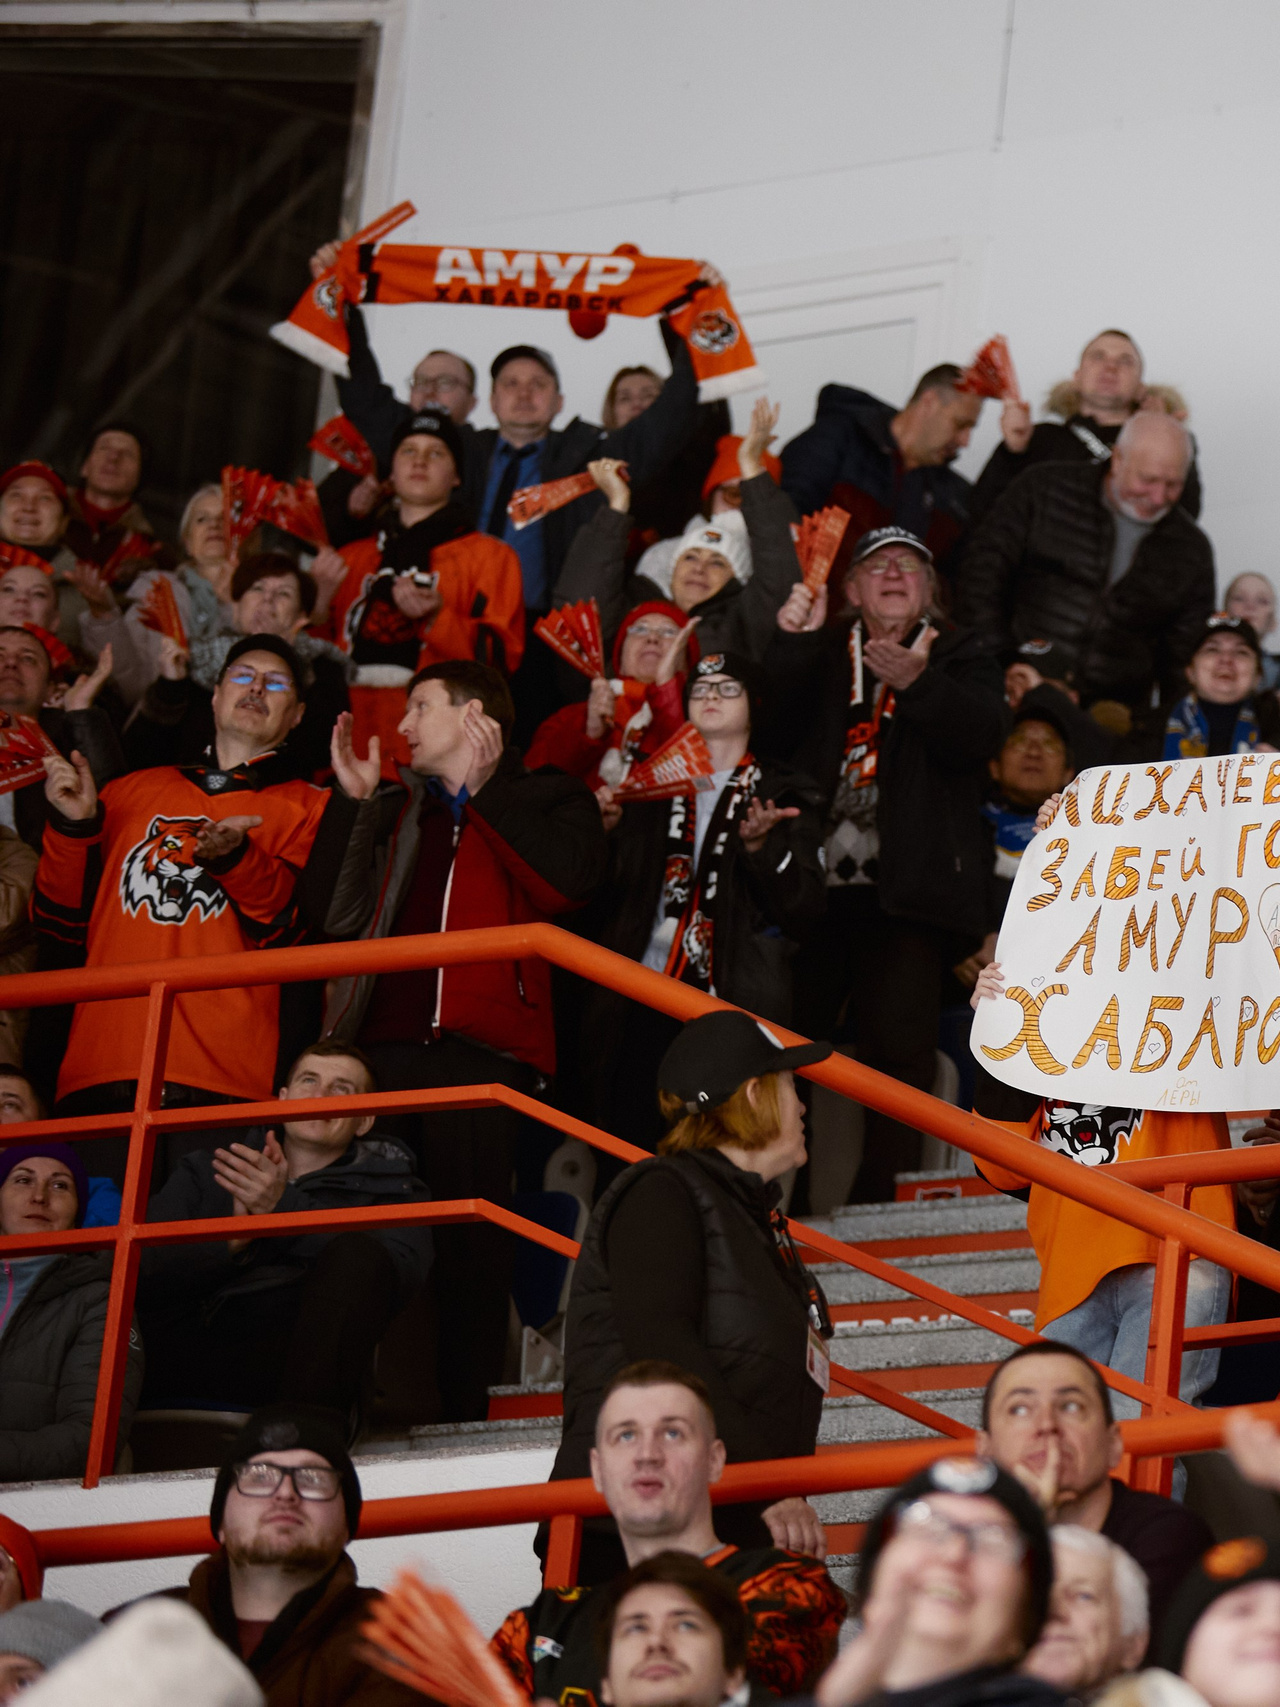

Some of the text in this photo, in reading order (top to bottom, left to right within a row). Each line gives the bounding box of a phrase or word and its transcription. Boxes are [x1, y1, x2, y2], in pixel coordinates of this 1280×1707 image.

[433, 248, 636, 293] АМУР
[435, 286, 624, 311] ХАБАРОВСК
[1027, 836, 1206, 912] ЗАБЕЙ
[1055, 886, 1250, 980] АМУР
[1155, 1088, 1201, 1107] ЛЕРЫ
